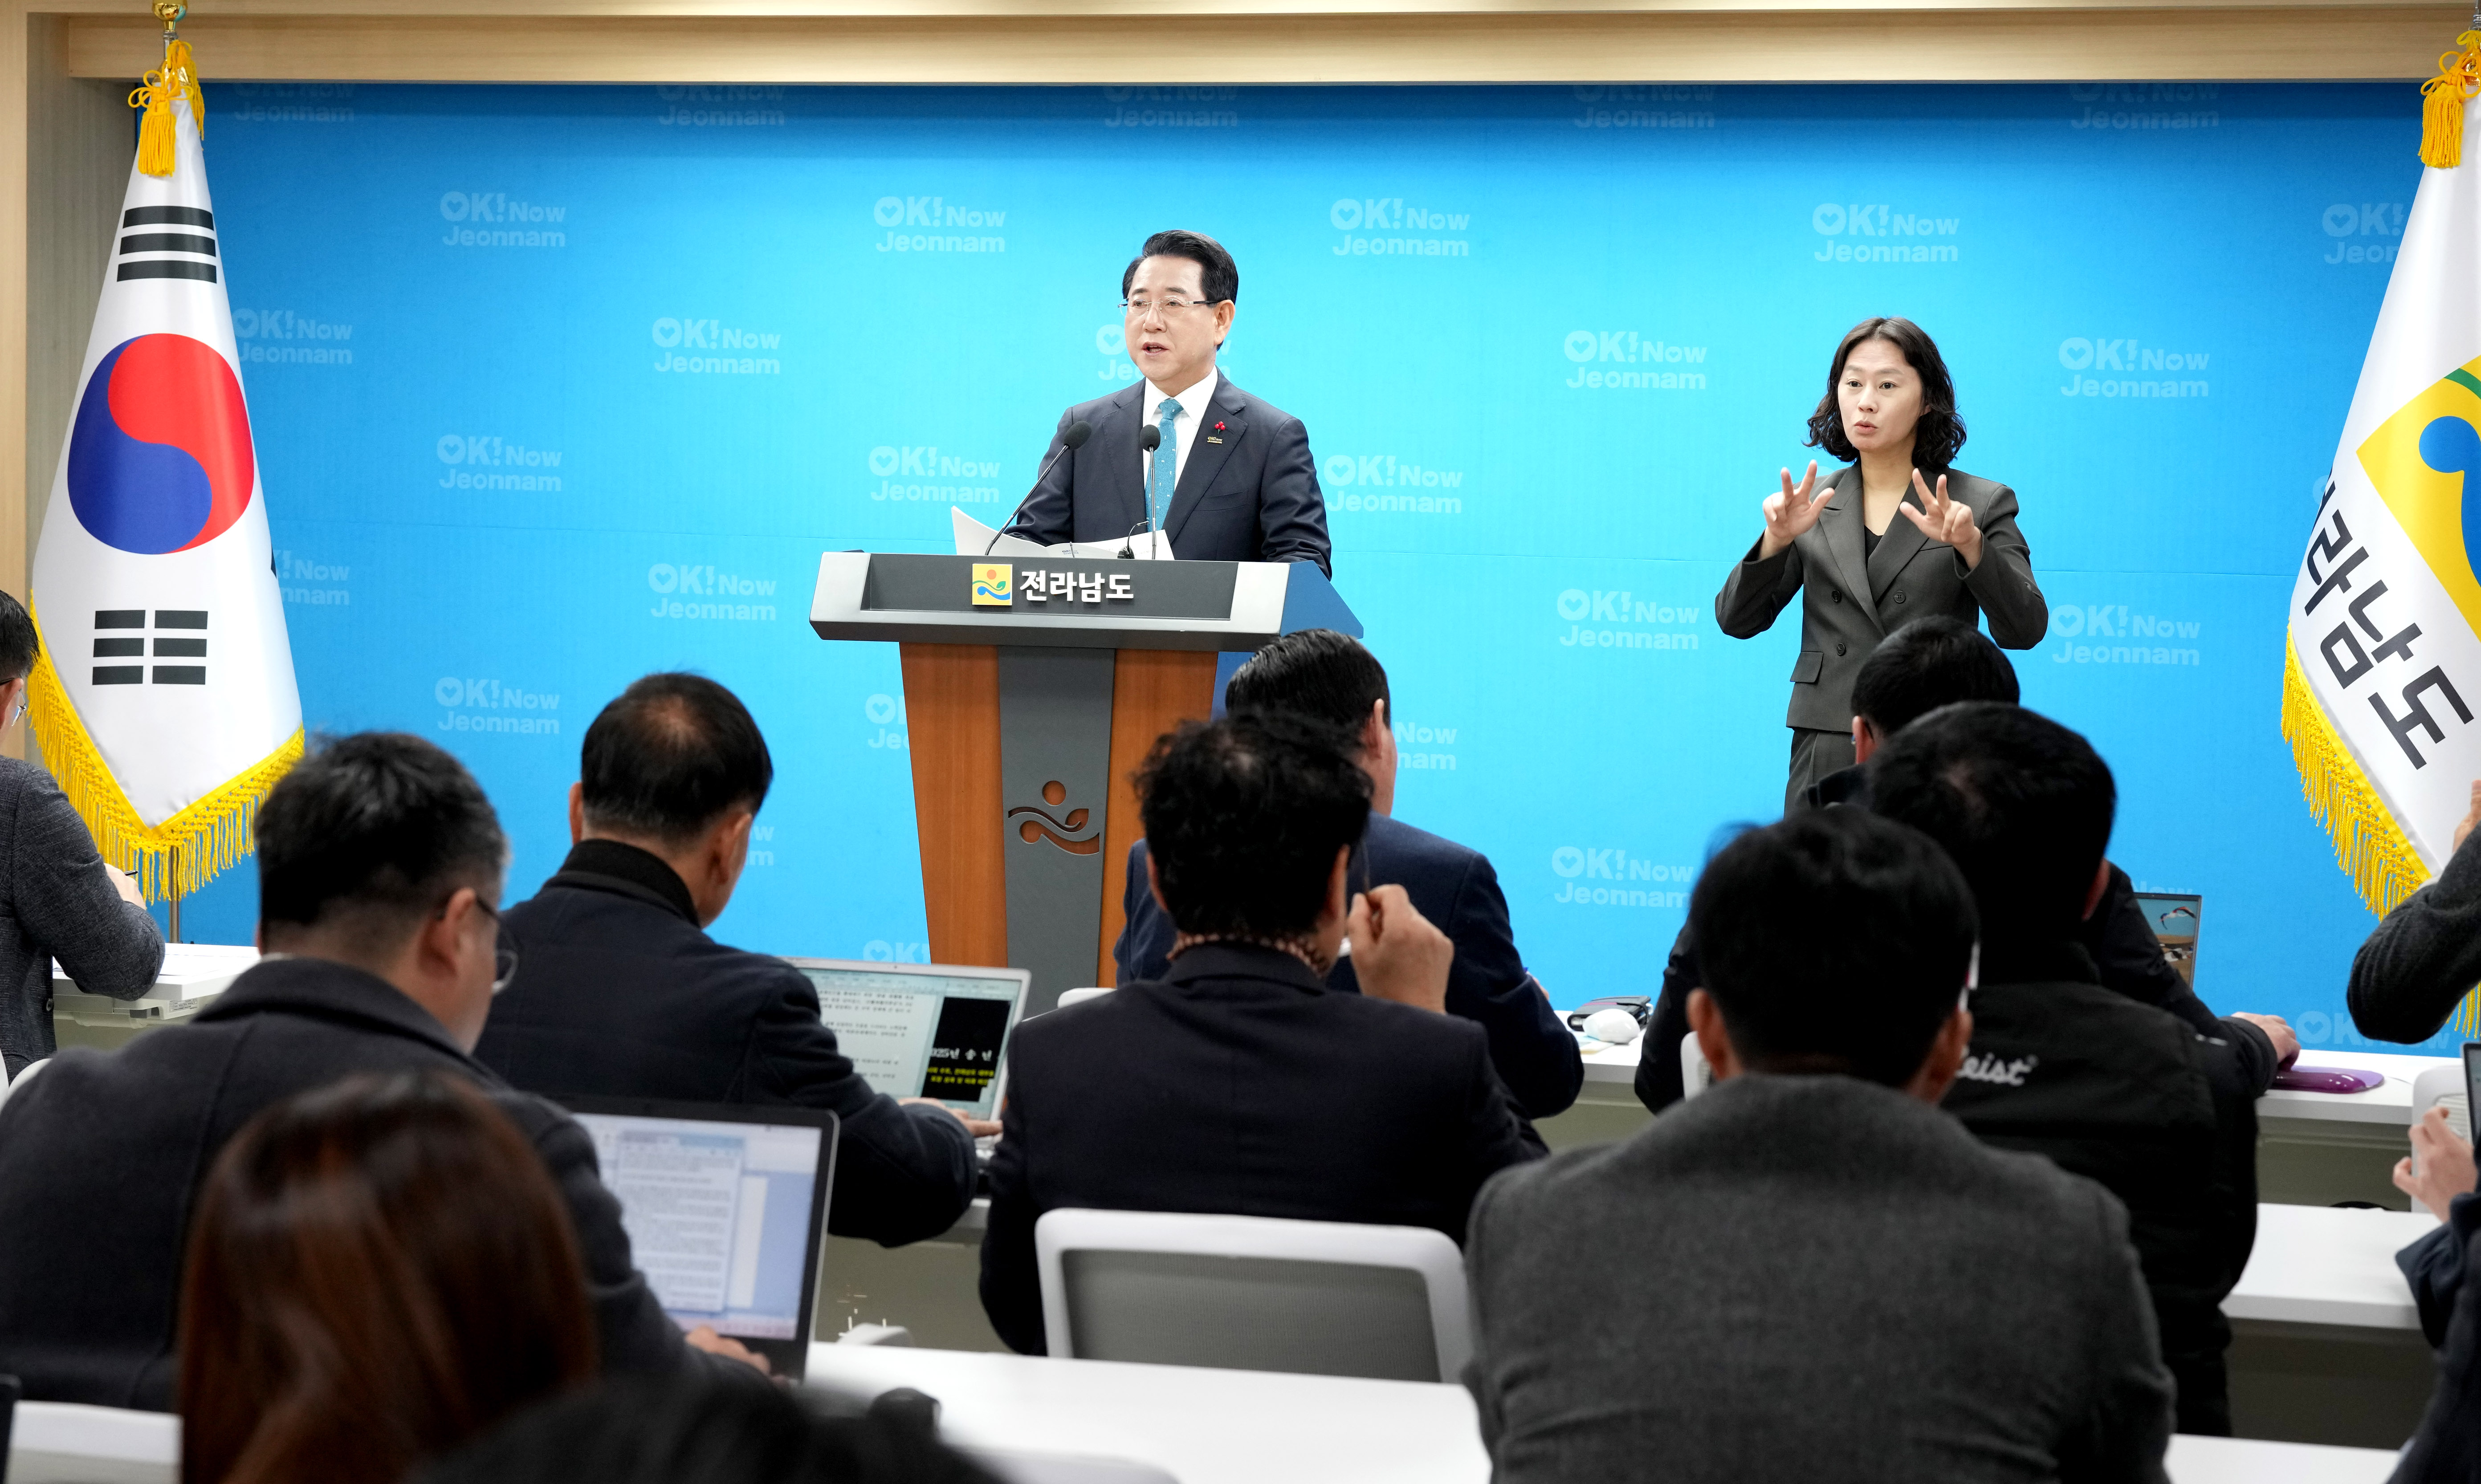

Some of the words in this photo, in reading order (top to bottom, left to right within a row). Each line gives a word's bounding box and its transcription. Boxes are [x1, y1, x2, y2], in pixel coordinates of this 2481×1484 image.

[235, 102, 353, 122] Jeonnam
[658, 106, 785, 126] Jeonnam
[1104, 107, 1237, 127] Jeonnam
[1574, 108, 1715, 128] Jeonnam
[2070, 107, 2219, 129] Jeonnam
[440, 191, 505, 223] OK!
[509, 202, 566, 223] Now
[874, 196, 942, 228] OK!
[946, 206, 1006, 227] Now
[1330, 199, 1403, 230] OK!
[1407, 208, 1470, 230] Now
[1812, 203, 1889, 236] OK!
[1894, 215, 1960, 236] Now
[2322, 203, 2404, 236] OK!
[442, 226, 566, 247] Jeonnam
[876, 231, 1005, 252] Jeonnam
[1332, 234, 1469, 256] Jeonnam
[1814, 240, 1958, 262] Jeonnam
[2324, 242, 2399, 264] Jeon
[233, 308, 294, 339] OK!
[298, 319, 352, 340] Now
[652, 317, 719, 349] OK!
[722, 329, 782, 350] Now
[1564, 330, 1638, 363] OK!
[1642, 341, 1707, 363] Now
[2058, 337, 2138, 371] OK!
[2142, 349, 2209, 370] Now
[654, 352, 780, 374] Jeonnam
[1566, 366, 1706, 389] Jeonnam
[2061, 375, 2209, 398] Jeonnam
[437, 435, 502, 466] OK!
[506, 446, 562, 467] Now
[868, 446, 937, 478] OK!
[941, 456, 1000, 478] Now
[439, 469, 562, 492] Jeonnam
[1324, 455, 1396, 487] OK!
[1400, 465, 1462, 488] Now
[870, 480, 999, 503] Jeonnam
[1325, 491, 1462, 513] Jeonnam
[295, 560, 350, 581] Now
[648, 563, 713, 595] OK!
[718, 574, 777, 596] Now
[281, 587, 350, 605] nnam
[1019, 570, 1134, 603] 전라남도
[650, 598, 776, 621] Jeonnam
[1557, 589, 1631, 623] OK!
[1634, 602, 1699, 624] Now
[2050, 604, 2128, 638] OK!
[2133, 615, 2200, 638] Now
[1560, 625, 1699, 649] Jeonnam
[2052, 641, 2200, 665] Jeonnam
[435, 677, 499, 708] OK!
[503, 688, 560, 709] Now
[437, 711, 560, 734] Jeonnam
[1394, 722, 1457, 744] Now
[1552, 846, 1625, 880] OK!
[1630, 860, 1693, 882] Now
[1554, 882, 1690, 907] Jeonnam
[2296, 1011, 2373, 1046] OK
